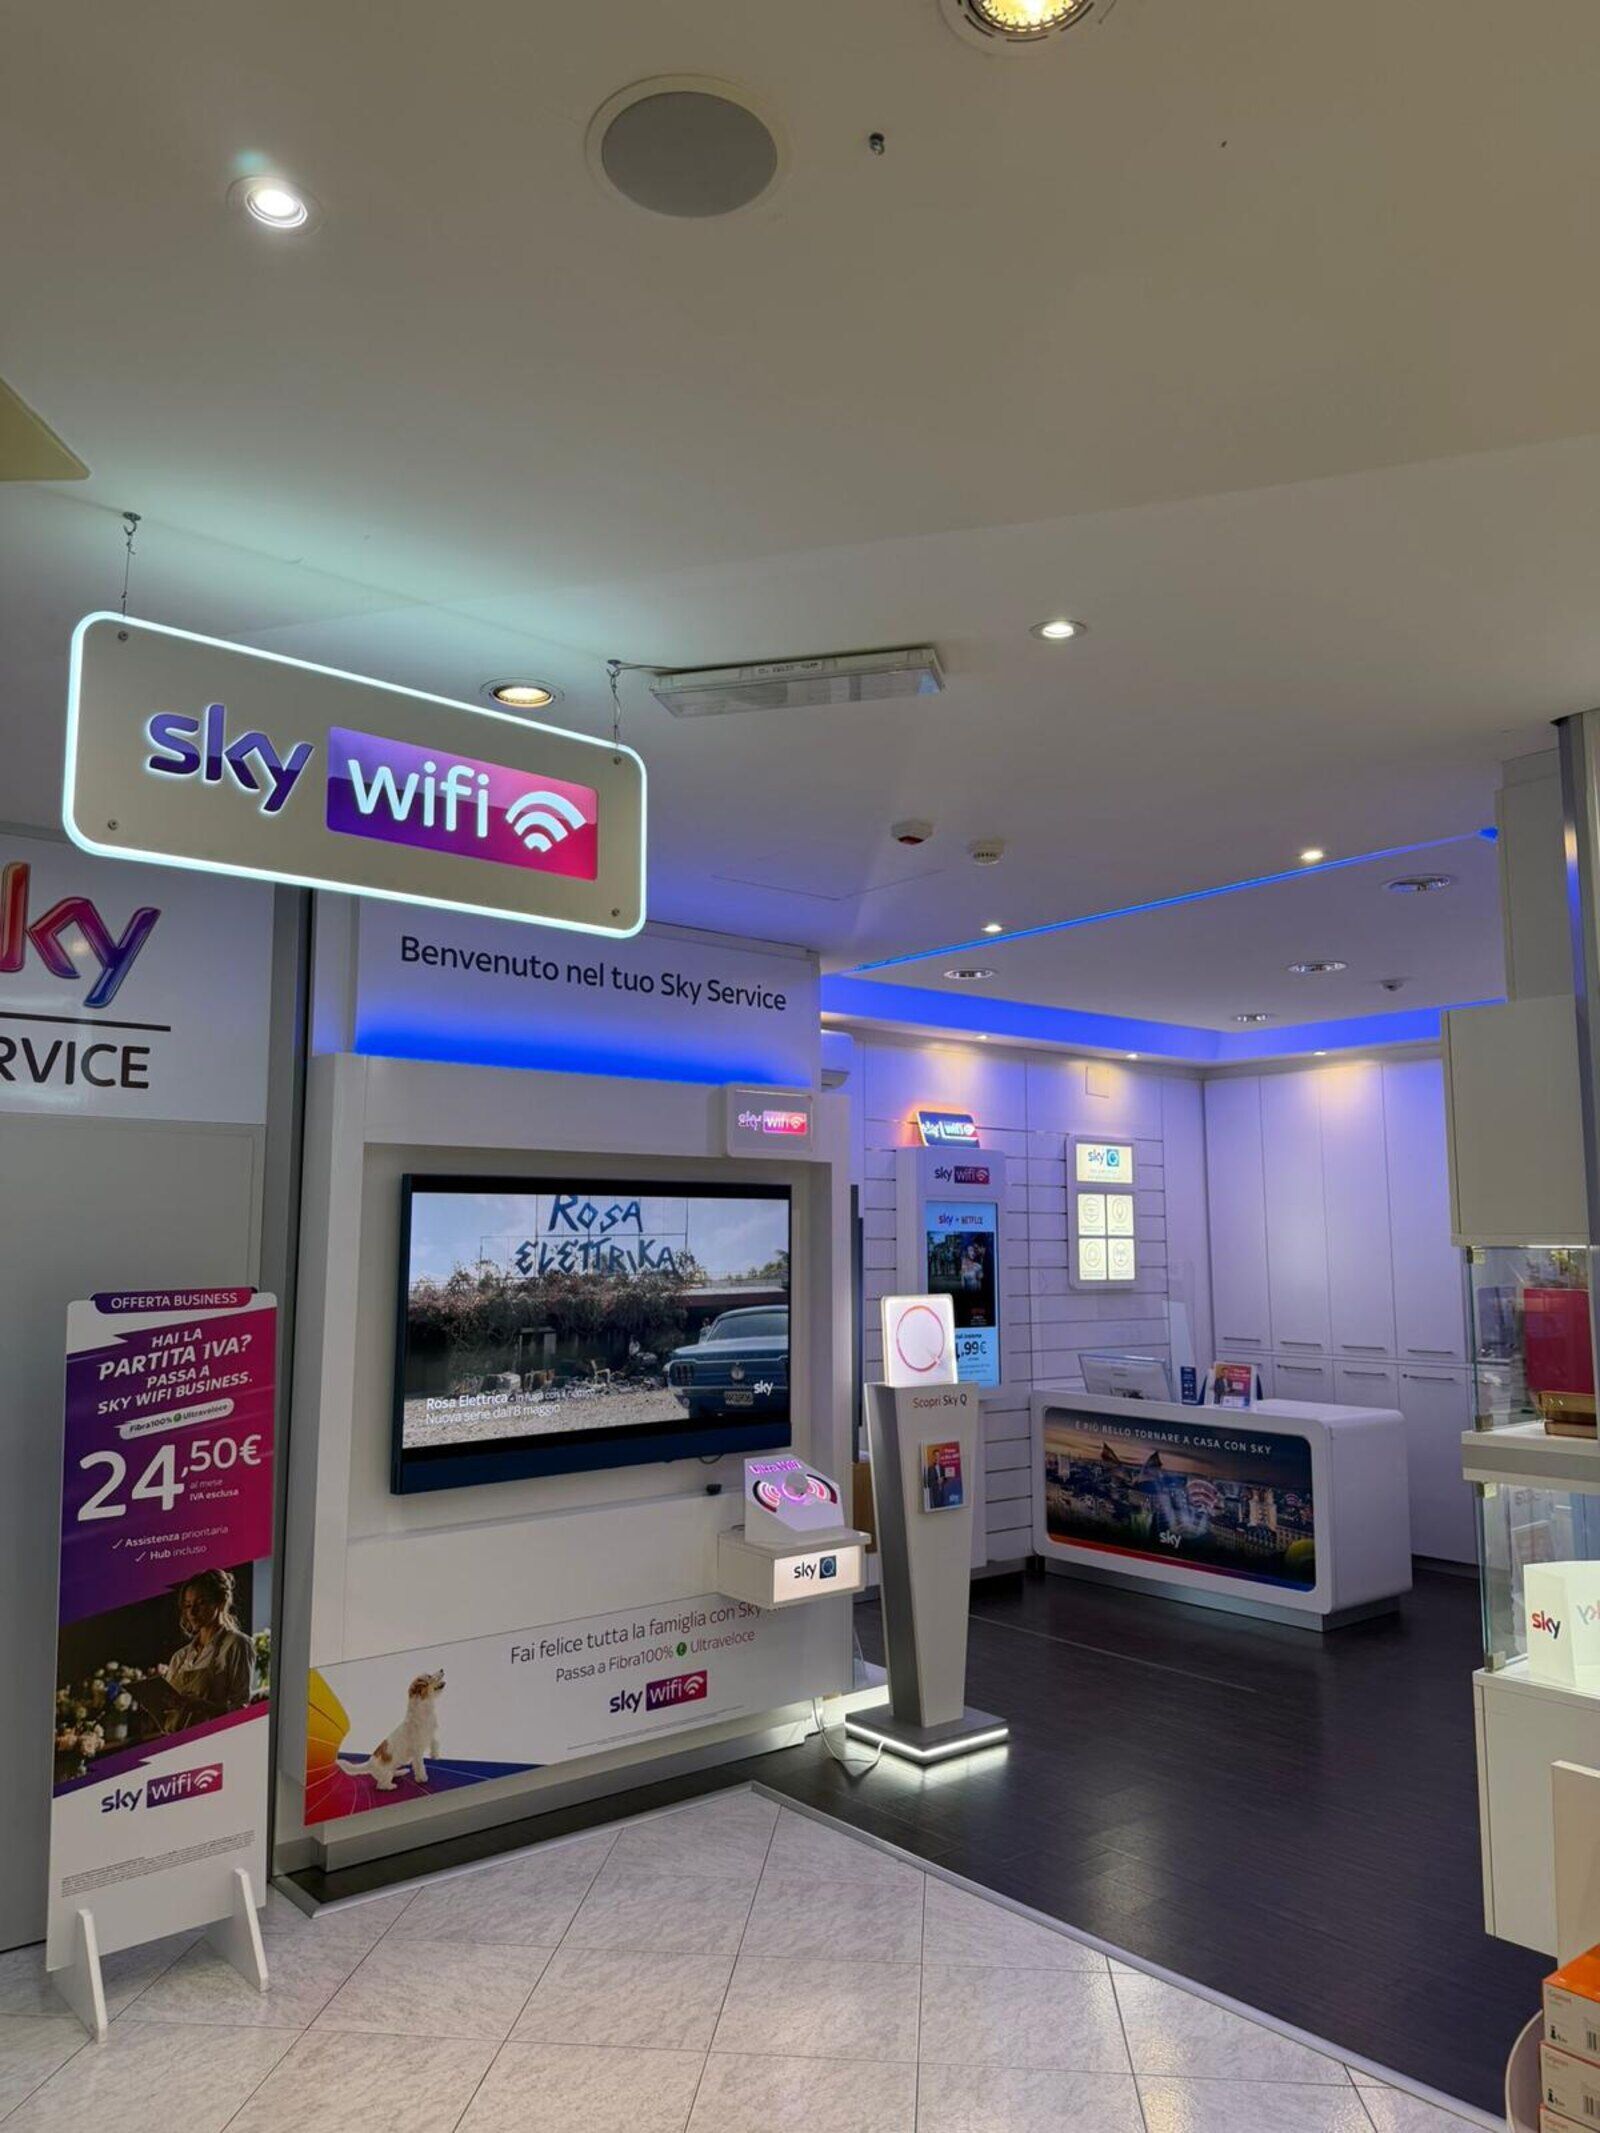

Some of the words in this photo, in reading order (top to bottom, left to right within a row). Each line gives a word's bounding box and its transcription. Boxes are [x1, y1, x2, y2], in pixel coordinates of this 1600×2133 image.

[146, 703, 314, 813] sky
[347, 760, 489, 838] wifi
[401, 936, 559, 981] Benvenuto
[567, 963, 604, 987] nel
[613, 966, 655, 993] tuo
[661, 973, 701, 1005] Sky
[707, 979, 787, 1011] Service
[1087, 1149, 1105, 1165] sky
[934, 1167, 952, 1183] sky
[548, 1194, 643, 1233] ROSA
[938, 1213, 953, 1226] sky
[514, 1236, 679, 1276] ELETTRIKA
[111, 1296, 171, 1309] OFFERTA
[174, 1292, 238, 1306] BUSINESS
[152, 1332, 179, 1348] HAI
[183, 1328, 202, 1342] LA
[99, 1346, 196, 1380] PARTITA
[203, 1334, 253, 1359] IVA?
[147, 1368, 196, 1388] PASSA
[199, 1365, 210, 1378] A
[754, 1380, 774, 1396] sky
[97, 1396, 132, 1414] SKY
[136, 1389, 172, 1406] WIFI
[175, 1371, 253, 1398] BUSINESS.
[426, 1397, 456, 1411] Rosa
[459, 1391, 508, 1408] Elettrica
[913, 1397, 941, 1409] Scopri
[943, 1394, 958, 1407] Sky
[960, 1393, 968, 1406] Q
[183, 1404, 228, 1420] Ultraveloce
[426, 1410, 461, 1425] Nuova
[463, 1407, 491, 1422] serie
[523, 1402, 561, 1418] maggio
[1102, 1426, 1131, 1437] BELLO
[1134, 1429, 1180, 1444] TORNARE
[1183, 1436, 1190, 1445] A
[1193, 1437, 1220, 1449] CASA
[1224, 1440, 1247, 1452] CON
[1250, 1444, 1272, 1455] SKY
[189, 1492, 204, 1501] IVA
[206, 1489, 240, 1499] esclusa
[124, 1533, 180, 1548] Assistenza
[181, 1525, 229, 1542] prioritaria
[1159, 1530, 1182, 1548] sky
[150, 1551, 171, 1561] Hub
[173, 1545, 207, 1557] incluso
[793, 1561, 817, 1580] sky
[511, 1644, 535, 1664] Fai
[539, 1636, 583, 1659] felice
[586, 1627, 629, 1648] tutta
[632, 1623, 645, 1639] la
[649, 1611, 706, 1635] famiglia
[709, 1604, 736, 1624] con
[738, 1601, 761, 1619] Sky
[1531, 1610, 1561, 1640] sky
[556, 1663, 595, 1682] Passa
[597, 1664, 606, 1674] a
[609, 1646, 674, 1672] Fibra100%
[690, 1630, 755, 1653] Ultraveloce
[609, 1690, 643, 1713] sky
[649, 1681, 682, 1703] wifi
[101, 1787, 143, 1813] sky
[151, 1773, 192, 1801] wifi
